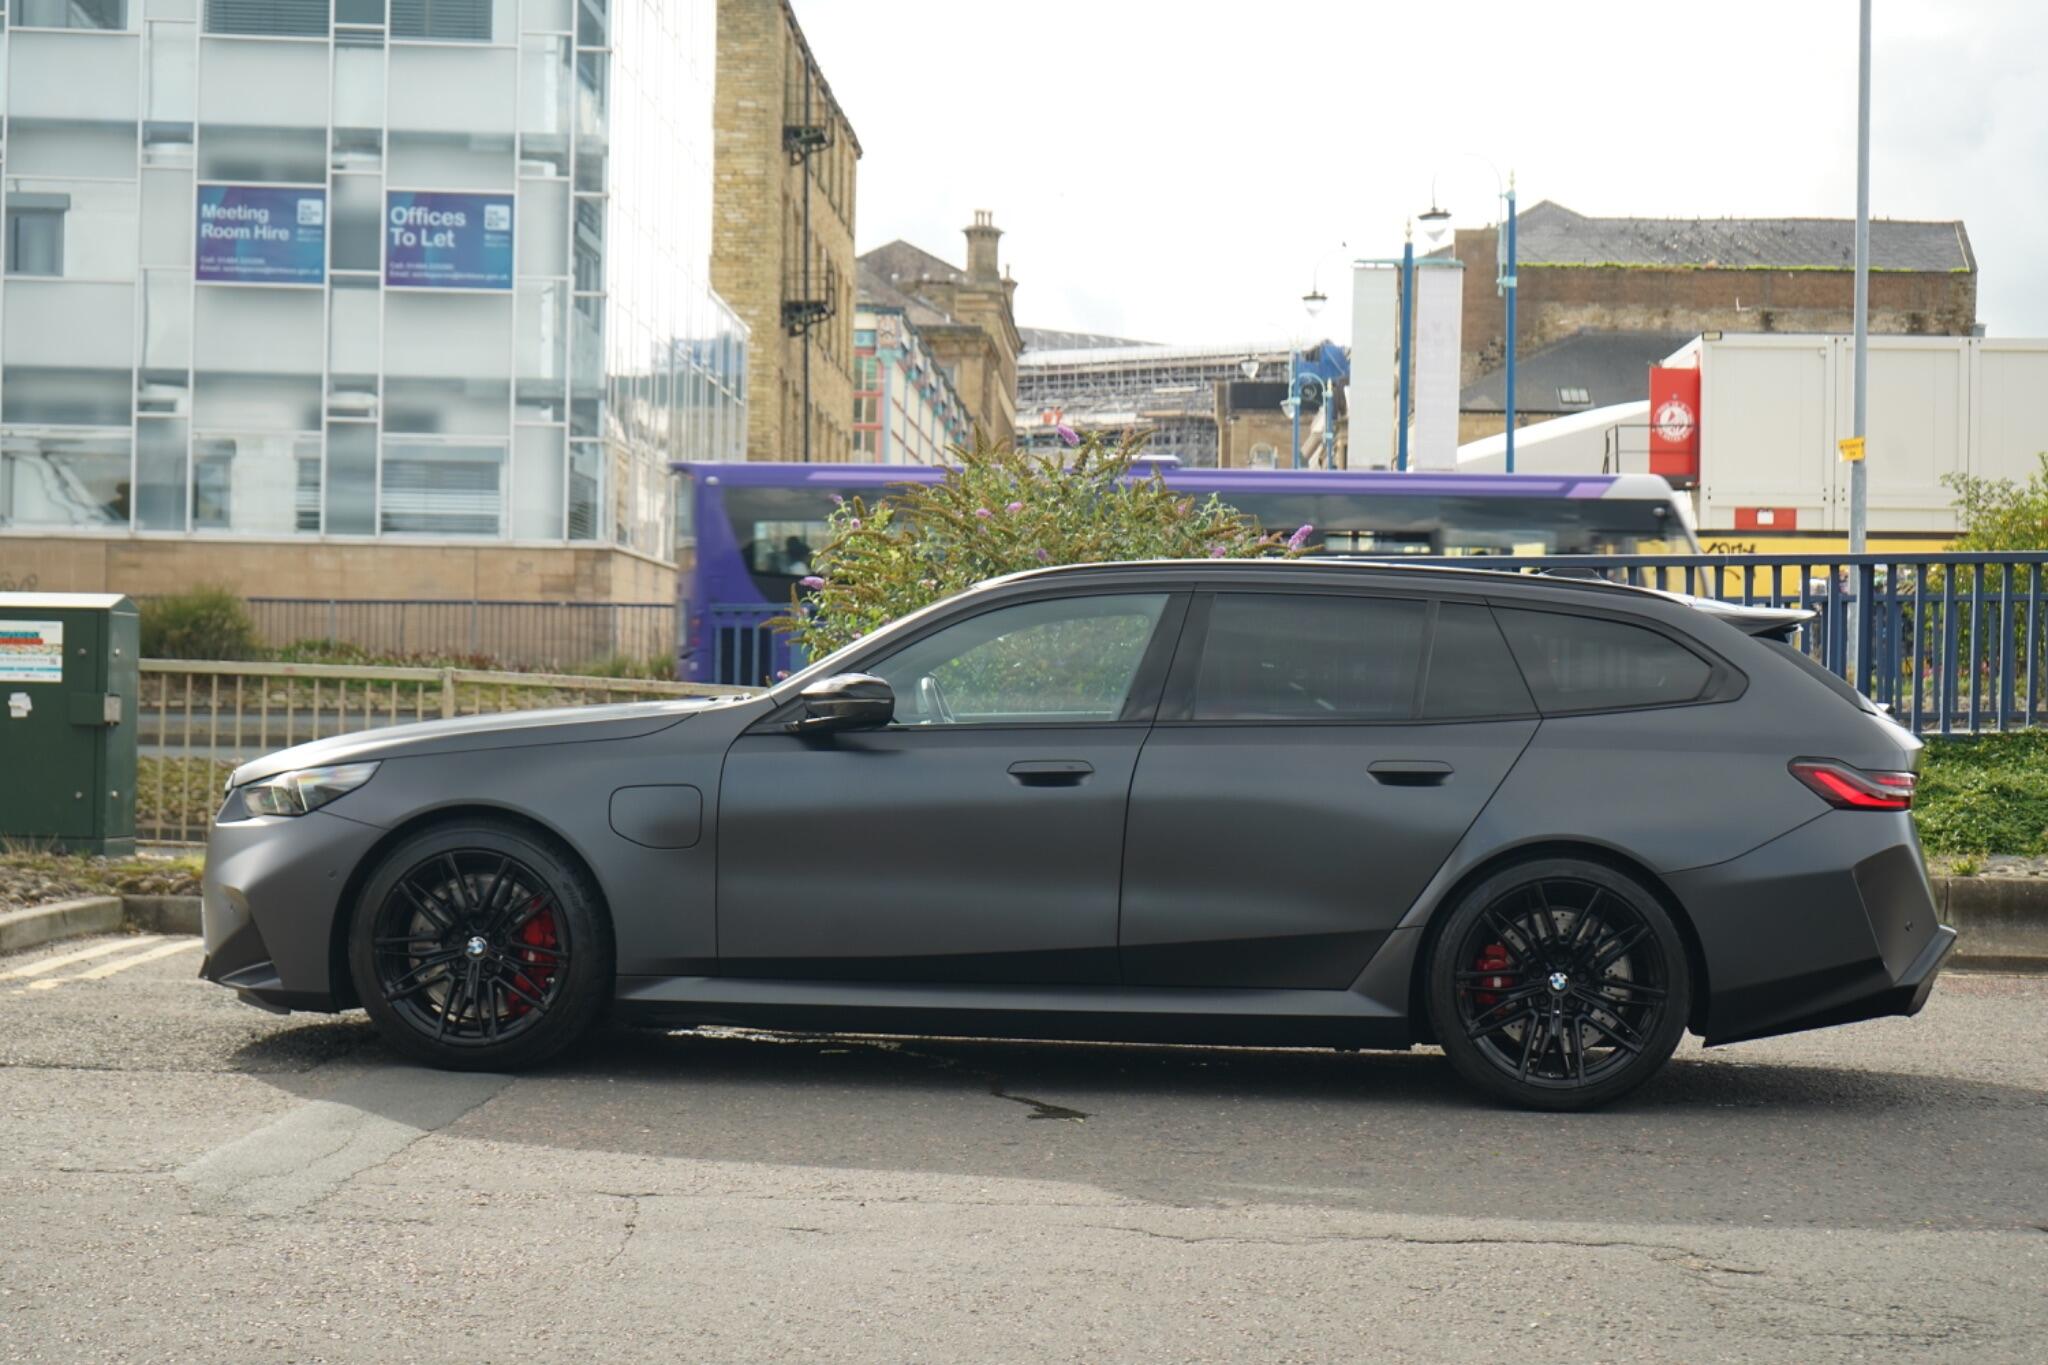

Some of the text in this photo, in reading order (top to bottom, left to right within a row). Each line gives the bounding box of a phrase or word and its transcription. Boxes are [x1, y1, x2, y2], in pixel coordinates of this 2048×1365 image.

[201, 203, 269, 224] Meeting
[390, 206, 466, 226] Offices
[201, 222, 251, 240] Room
[254, 223, 289, 241] Hire
[390, 227, 456, 248] To Let
